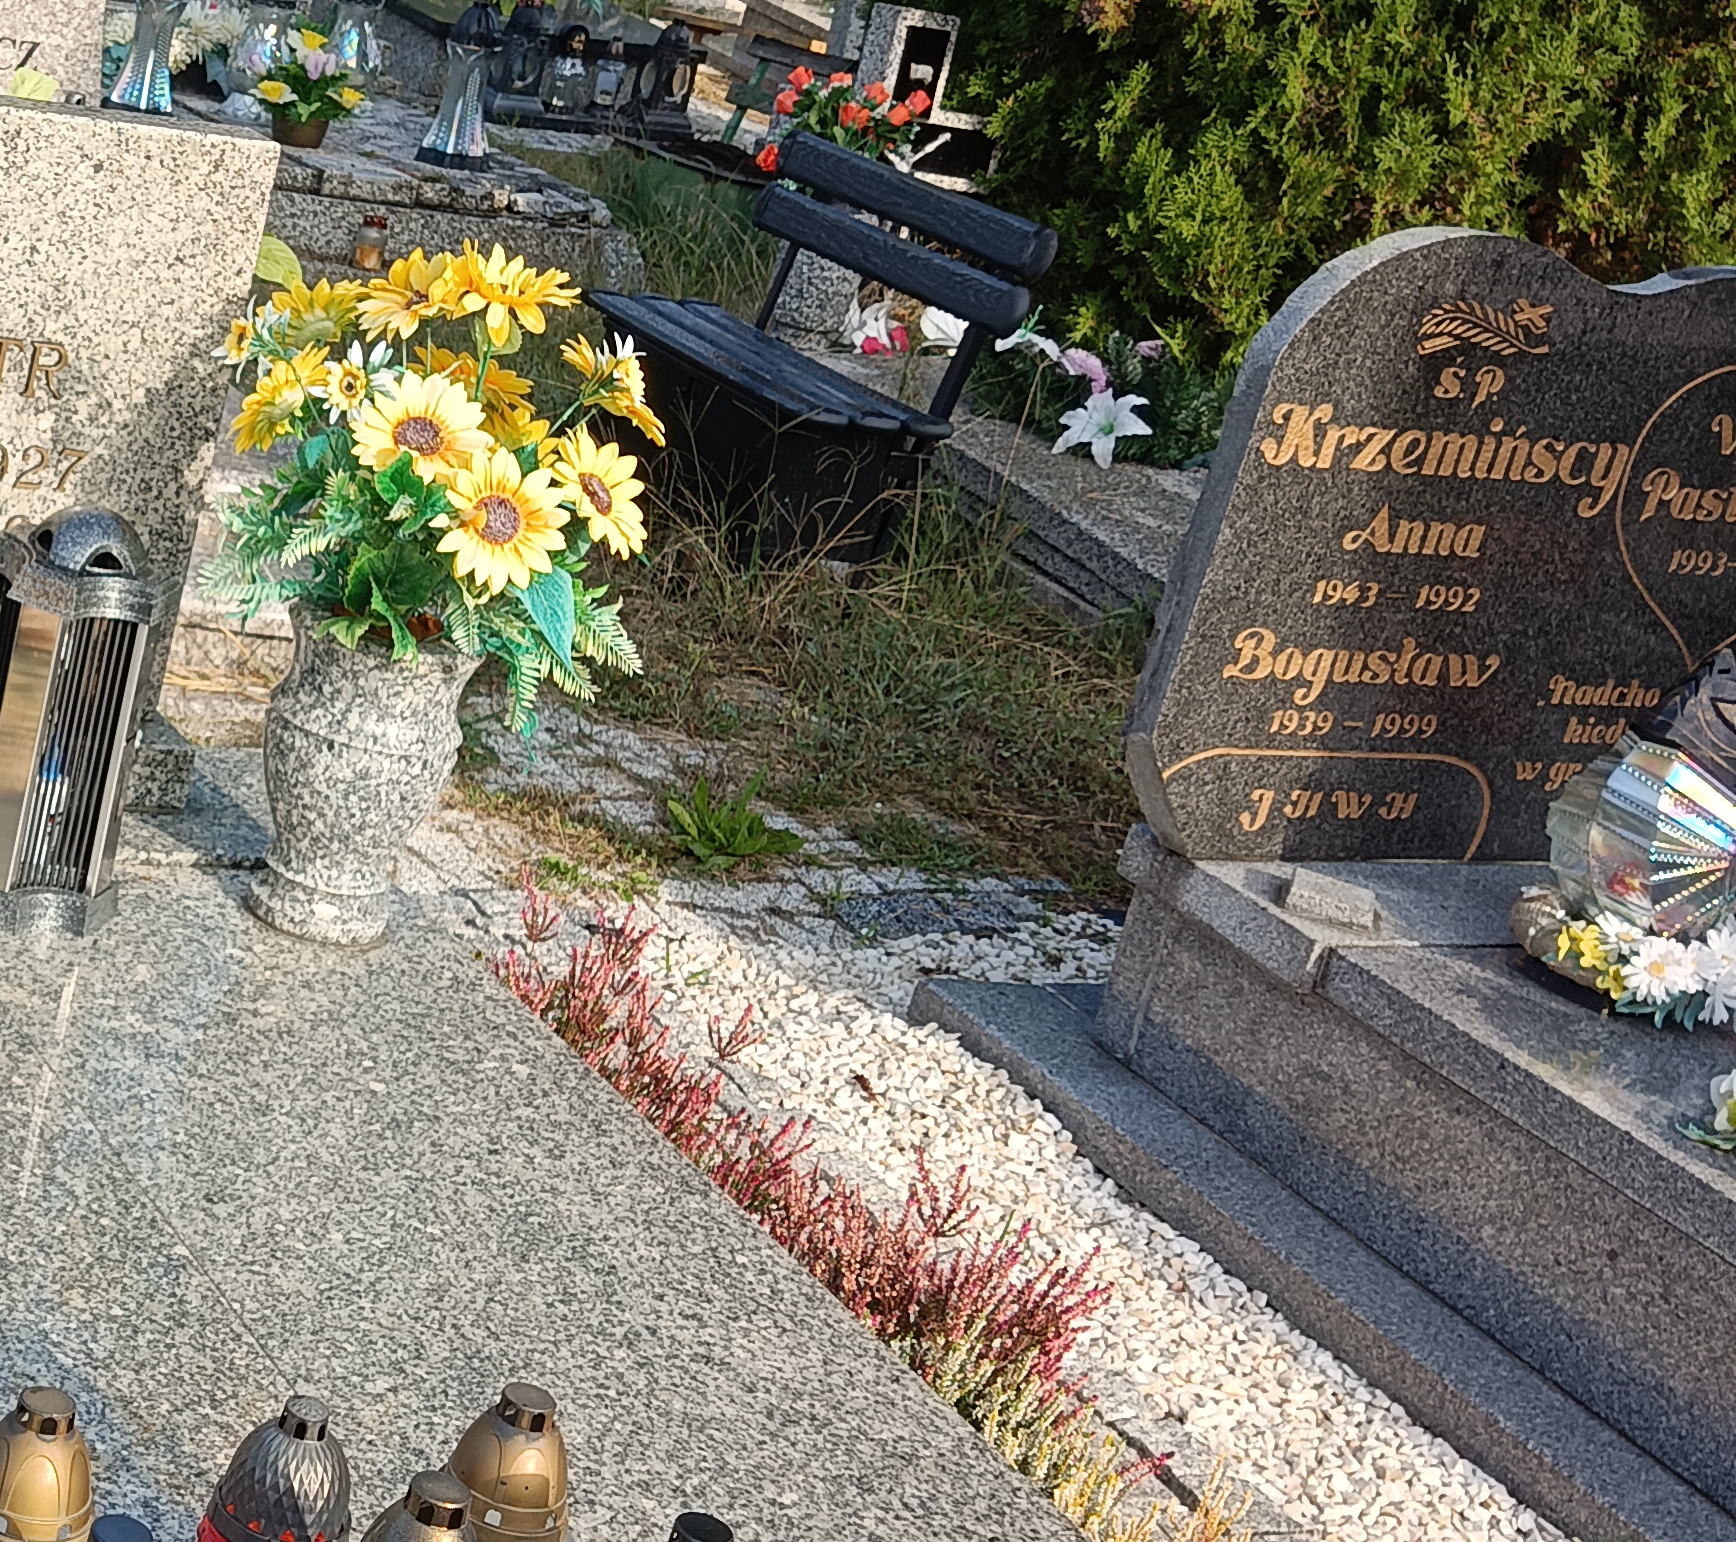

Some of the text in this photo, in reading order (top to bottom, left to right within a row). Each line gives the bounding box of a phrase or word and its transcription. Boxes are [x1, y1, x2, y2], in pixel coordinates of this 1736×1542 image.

[1259, 401, 1630, 519] Krzemińscy
[1342, 502, 1487, 558] Anna
[1221, 627, 1502, 706] Bogusław
